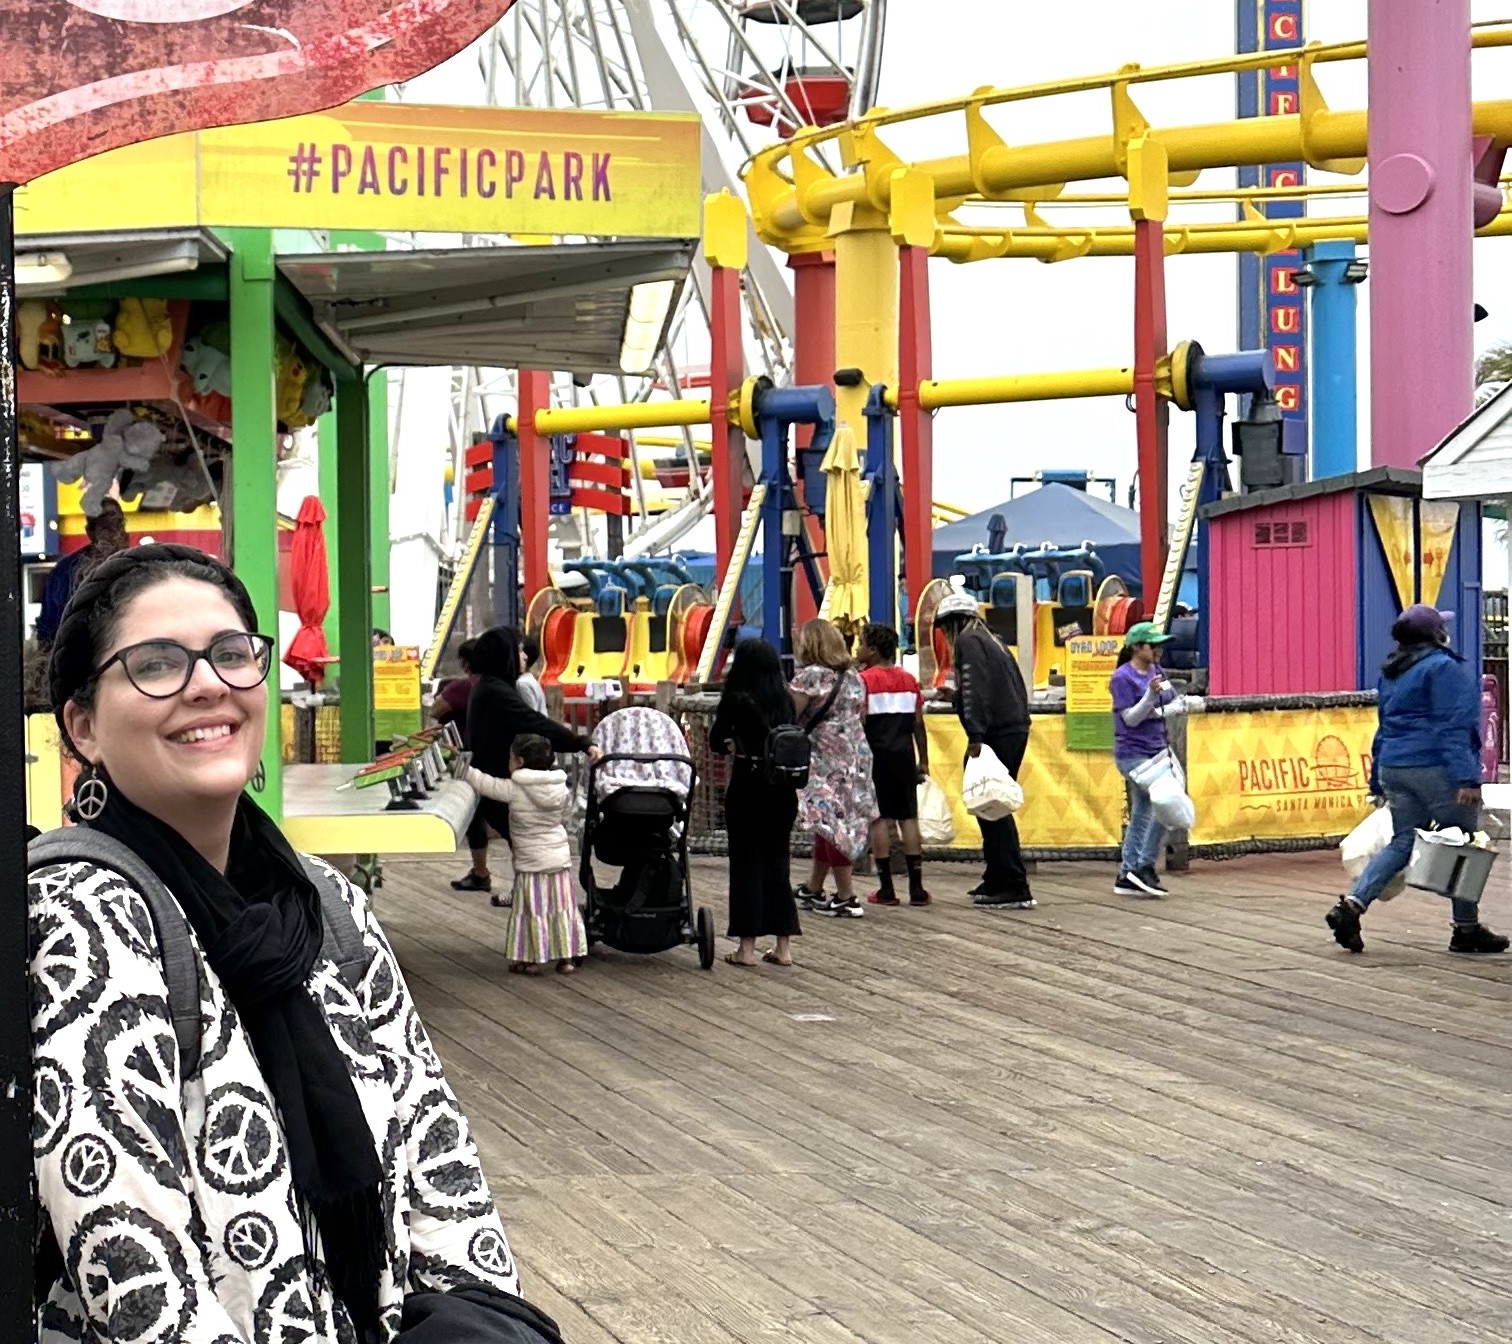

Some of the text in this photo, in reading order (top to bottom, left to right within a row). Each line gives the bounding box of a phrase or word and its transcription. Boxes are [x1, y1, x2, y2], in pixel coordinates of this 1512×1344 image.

[287, 143, 612, 202] #PACIFICPARK
[1238, 757, 1310, 791] PACIFIC
[1276, 797, 1309, 812] SANTA
[1313, 795, 1352, 809] MONICA
